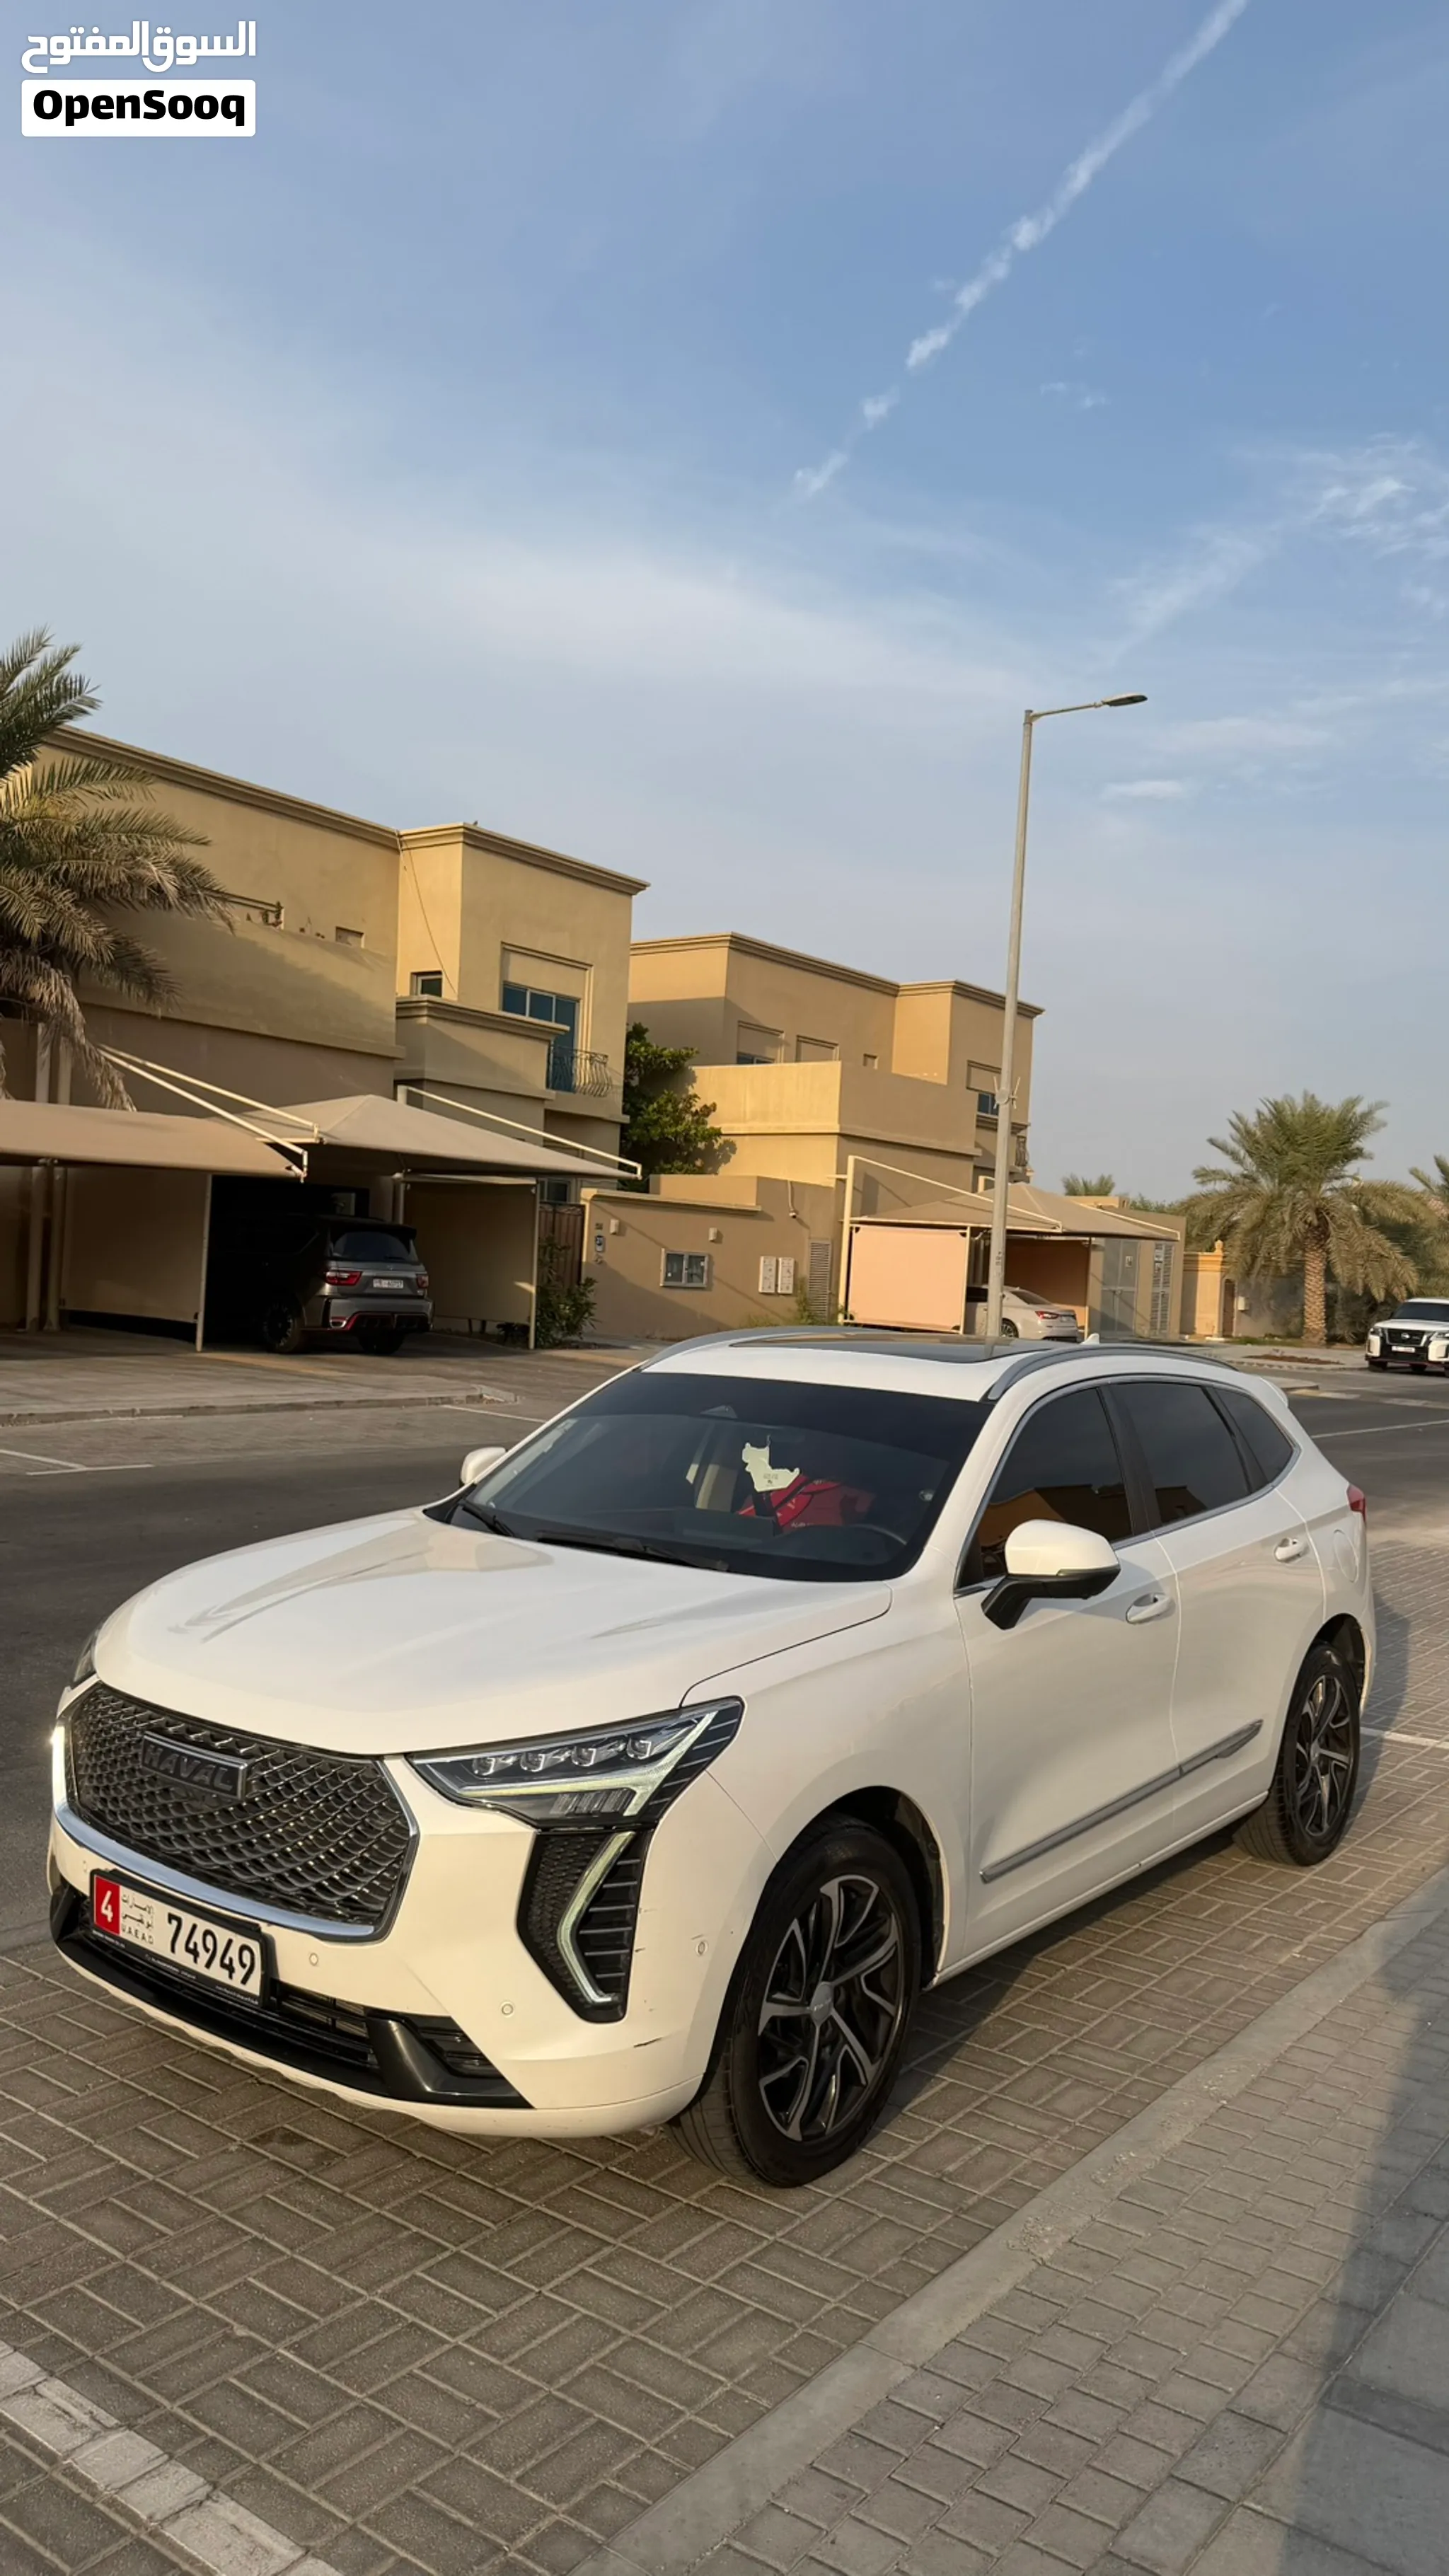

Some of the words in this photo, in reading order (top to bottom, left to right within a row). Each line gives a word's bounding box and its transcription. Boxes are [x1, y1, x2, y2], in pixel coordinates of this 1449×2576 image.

[144, 1744, 233, 1791] HAVAL
[100, 1890, 114, 1923] 4
[167, 1912, 256, 1986] 74949
